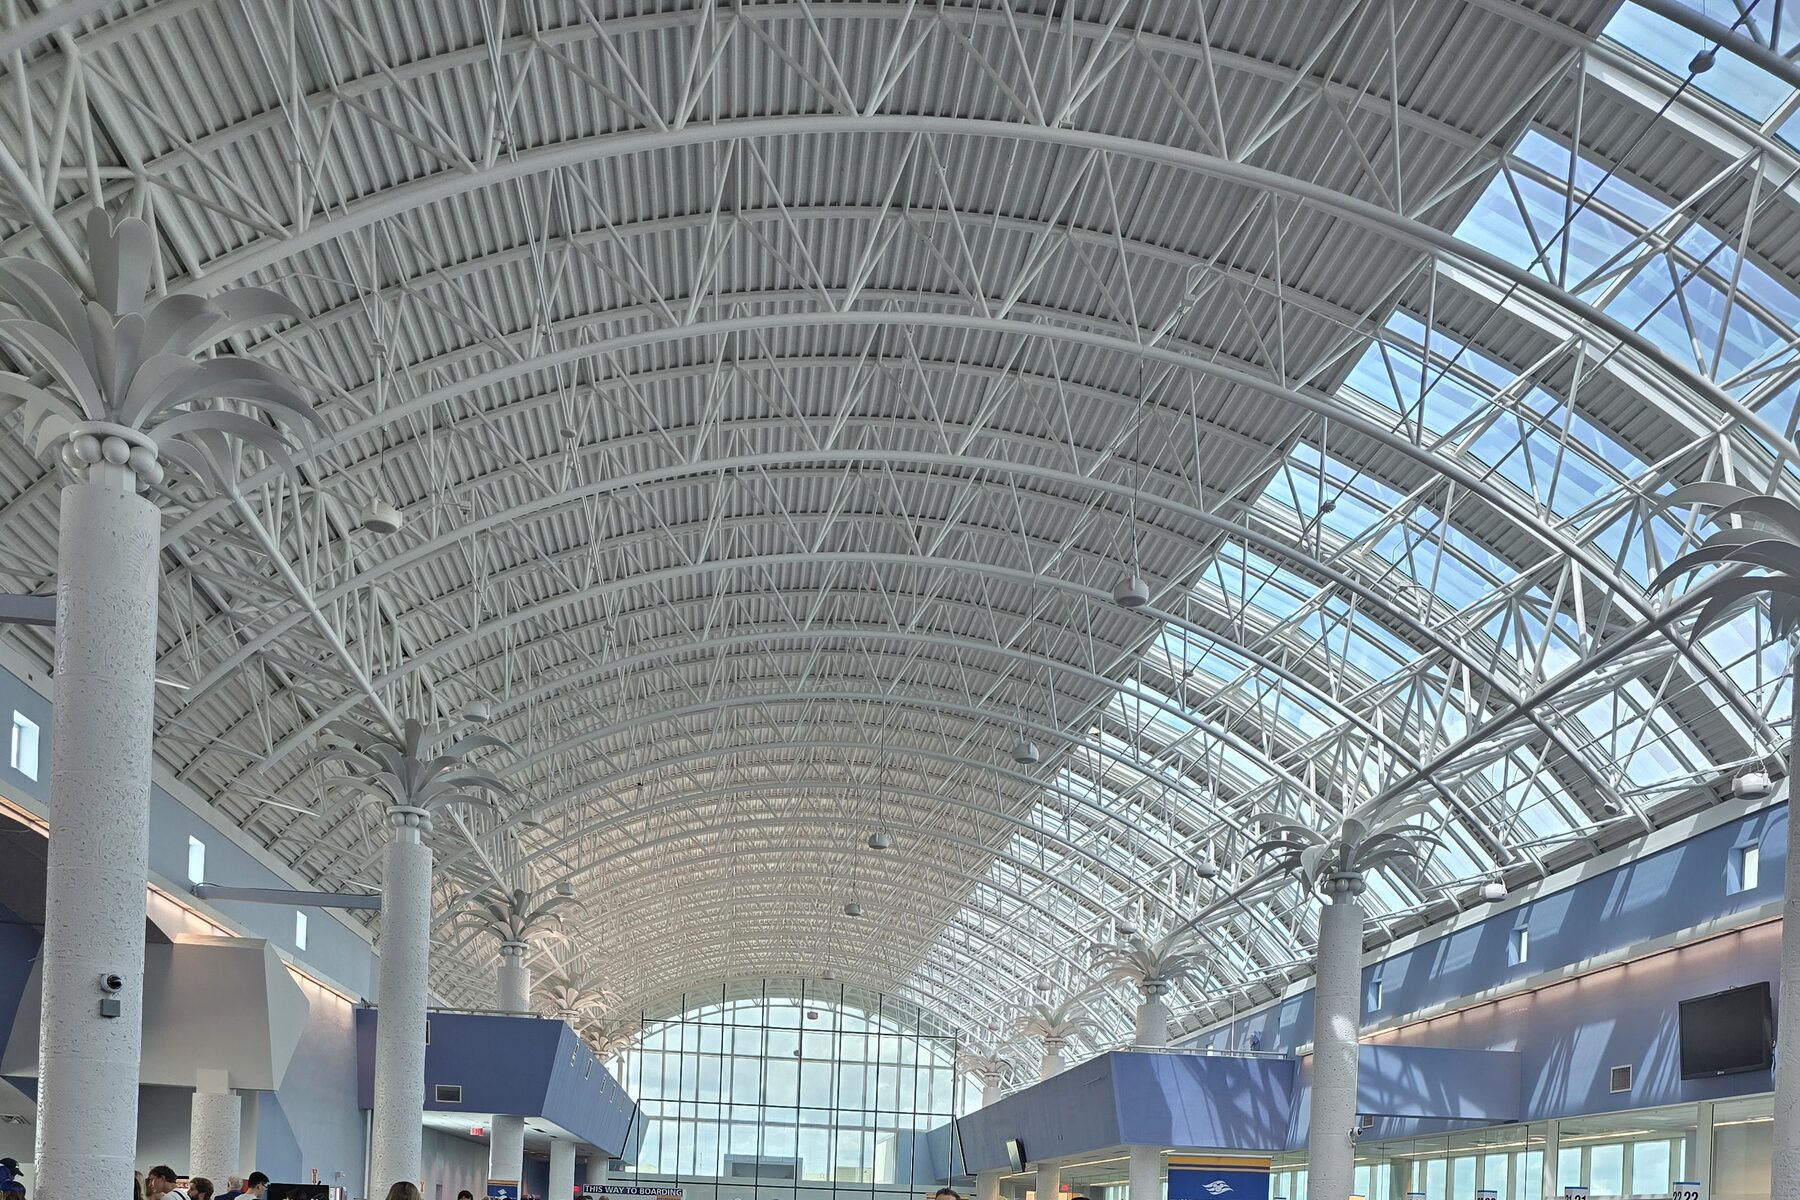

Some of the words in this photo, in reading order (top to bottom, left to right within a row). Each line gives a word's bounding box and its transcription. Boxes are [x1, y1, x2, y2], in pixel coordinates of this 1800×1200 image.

[585, 1185, 603, 1193] THIS
[605, 1186, 625, 1194] WAY
[626, 1187, 638, 1195] TO
[639, 1188, 682, 1196] BOARDING
